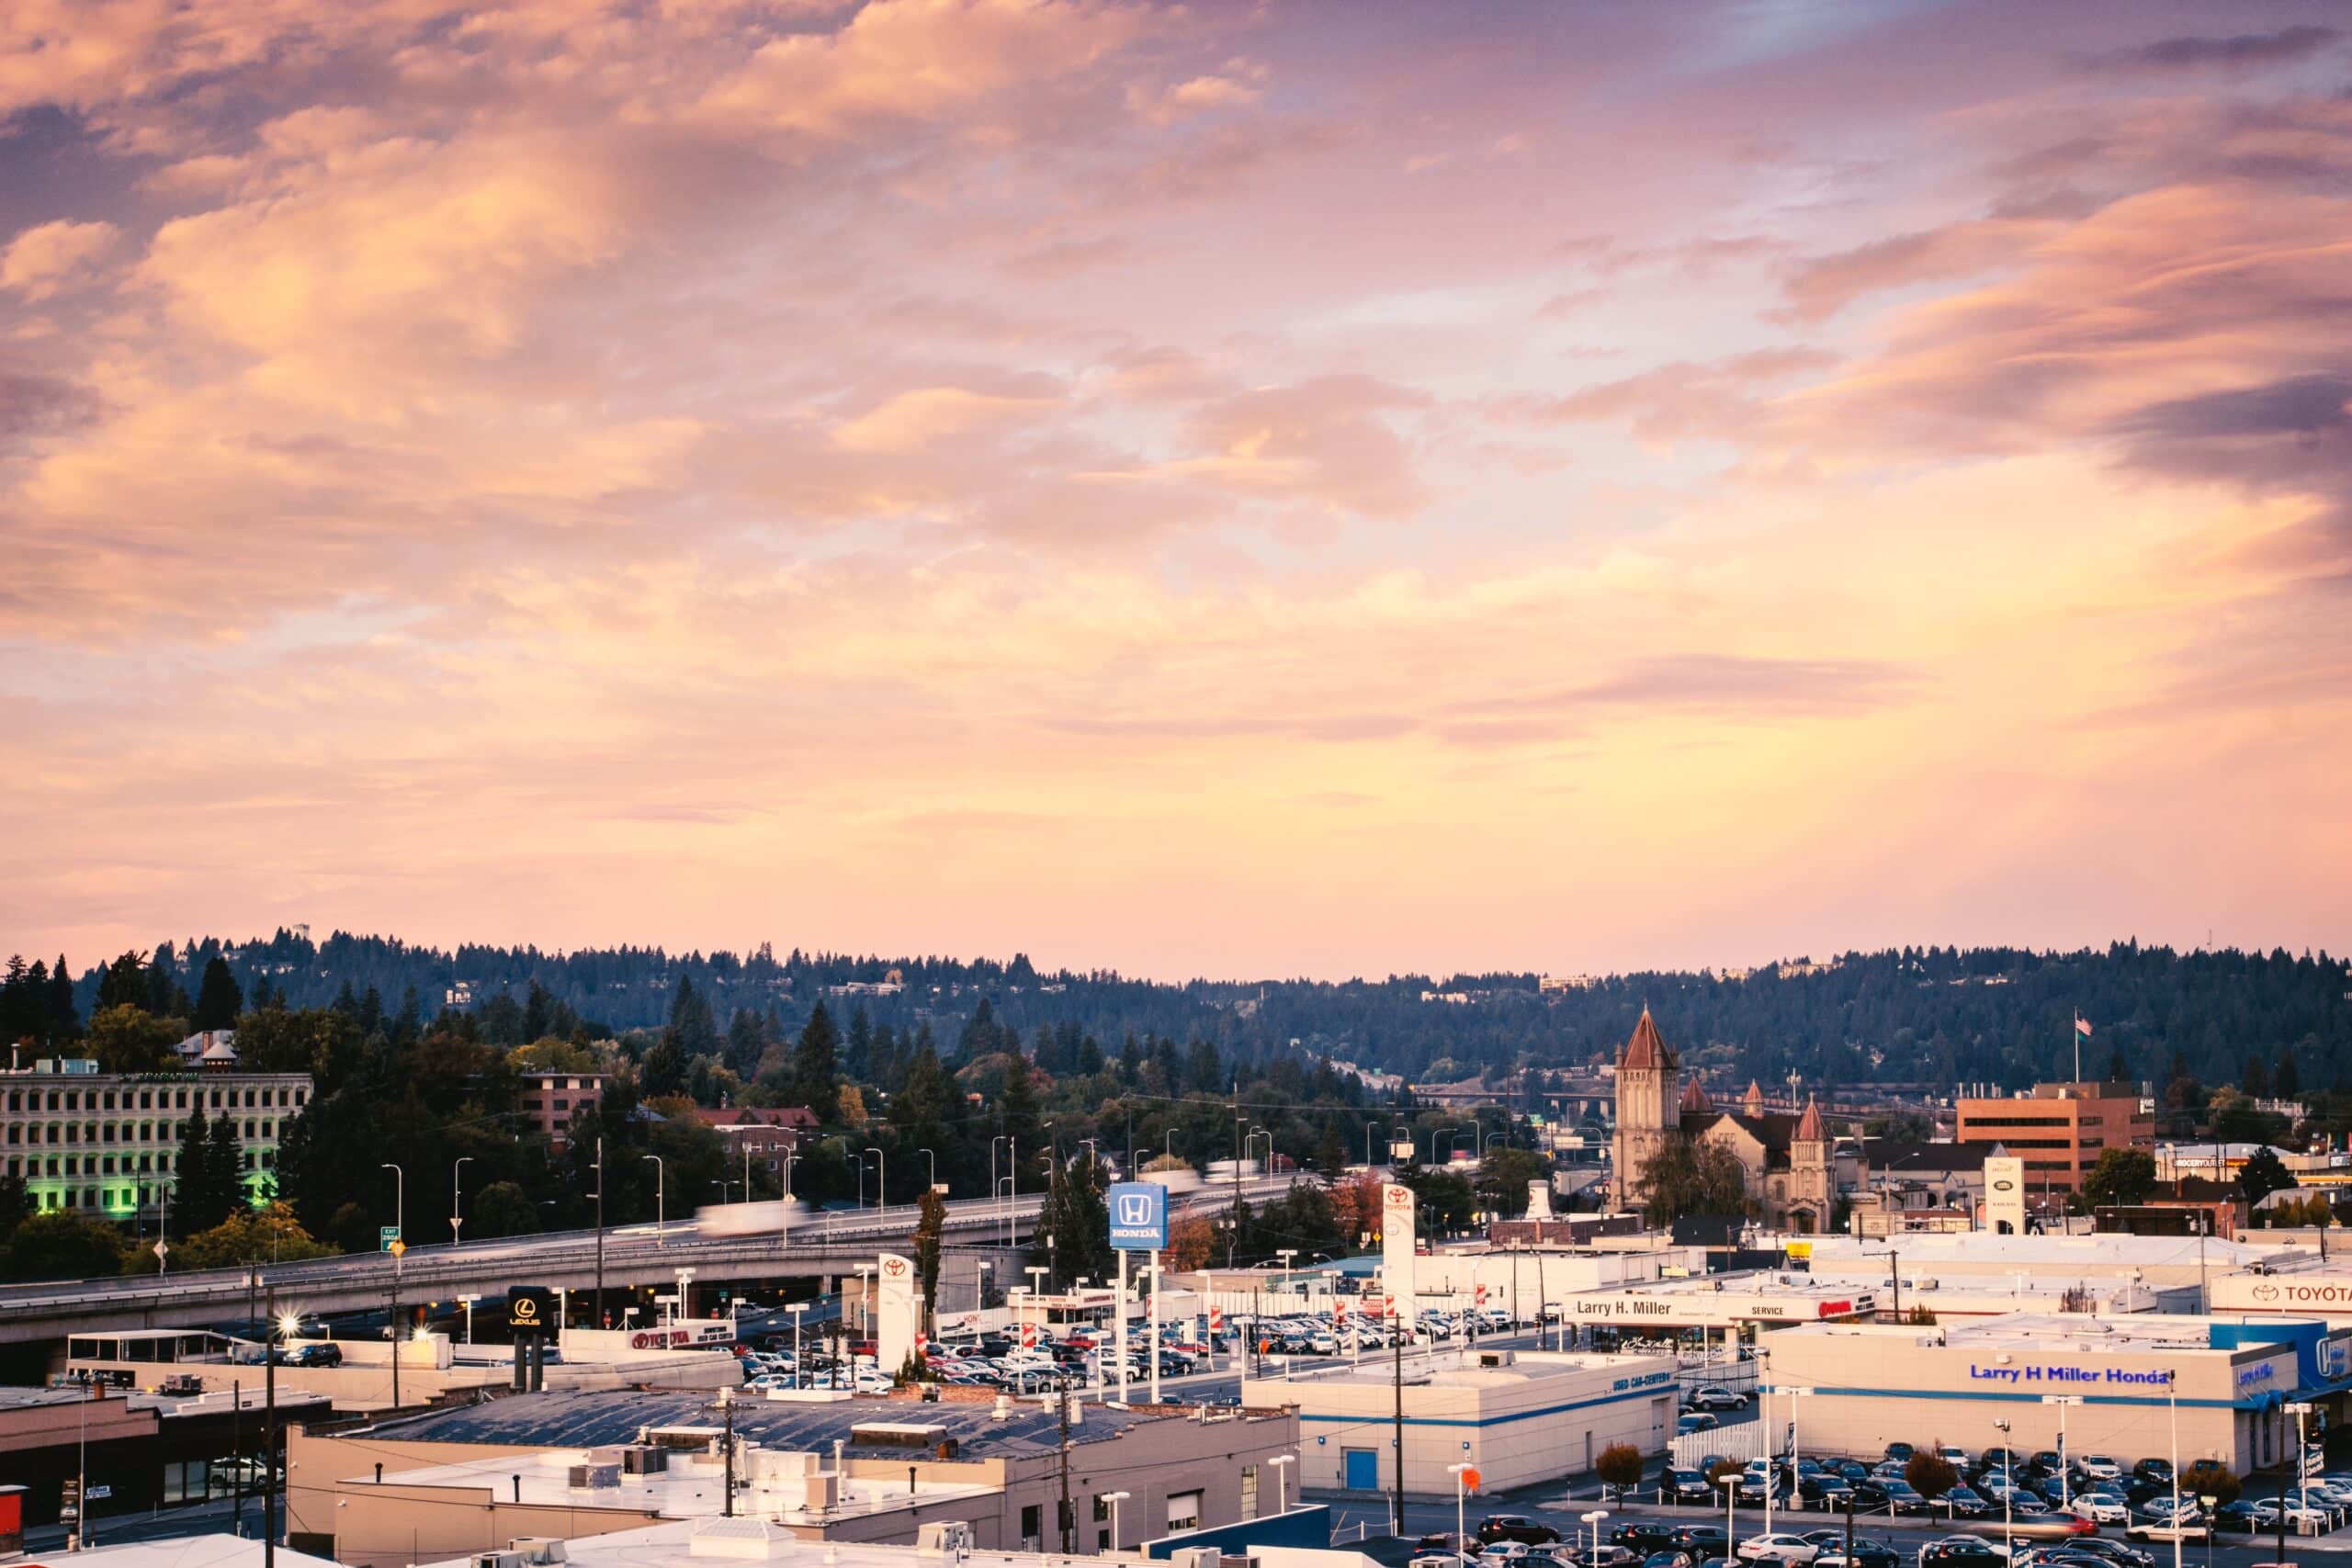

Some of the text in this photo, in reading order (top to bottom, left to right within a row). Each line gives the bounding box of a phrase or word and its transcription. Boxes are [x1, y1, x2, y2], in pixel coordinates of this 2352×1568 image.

[1112, 1228, 1160, 1238] HONDA
[1577, 1301, 1671, 1316] Larry H. Miller
[1752, 1306, 1784, 1315] SERVICE
[1971, 1364, 2170, 1384] Larry H Miller Honda
